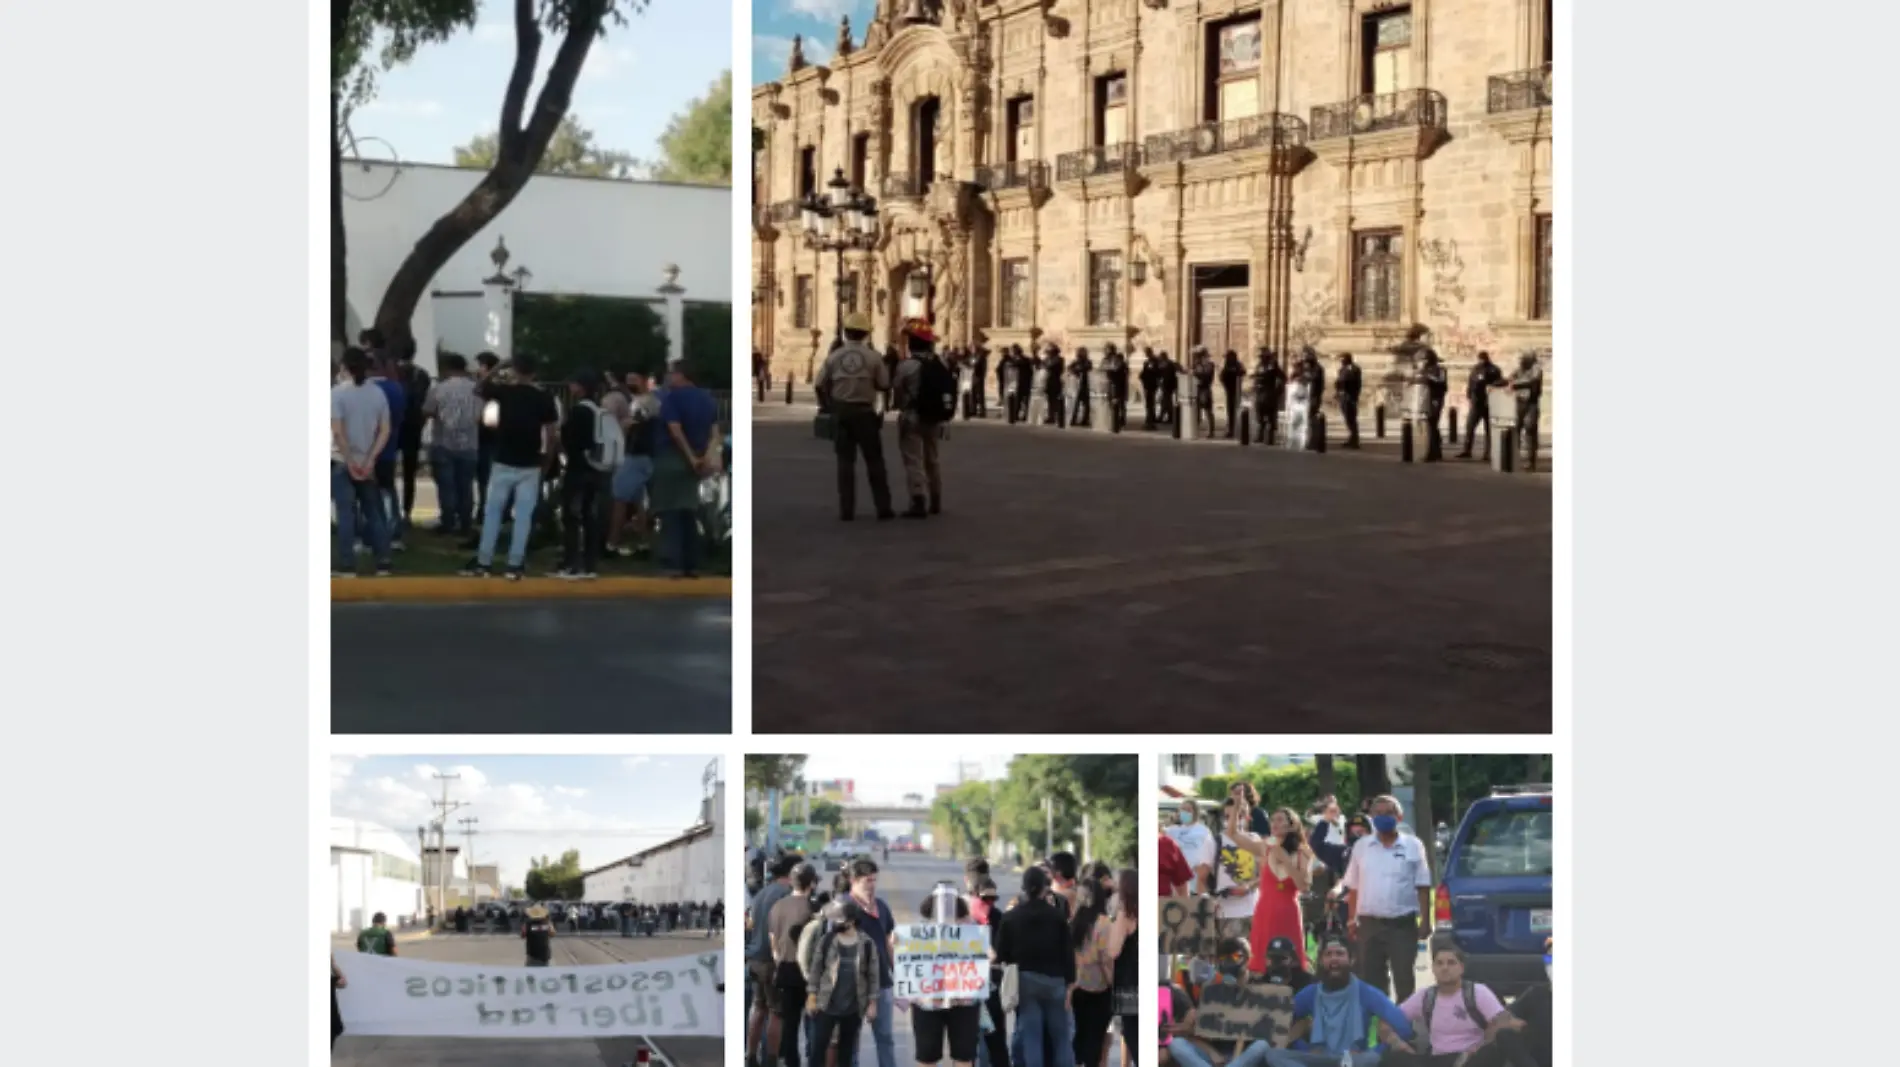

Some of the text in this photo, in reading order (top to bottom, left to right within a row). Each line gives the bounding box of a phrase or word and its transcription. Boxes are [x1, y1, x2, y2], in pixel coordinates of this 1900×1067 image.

[903, 960, 978, 977] TE MATA
[898, 977, 985, 996] EL GOBNO
